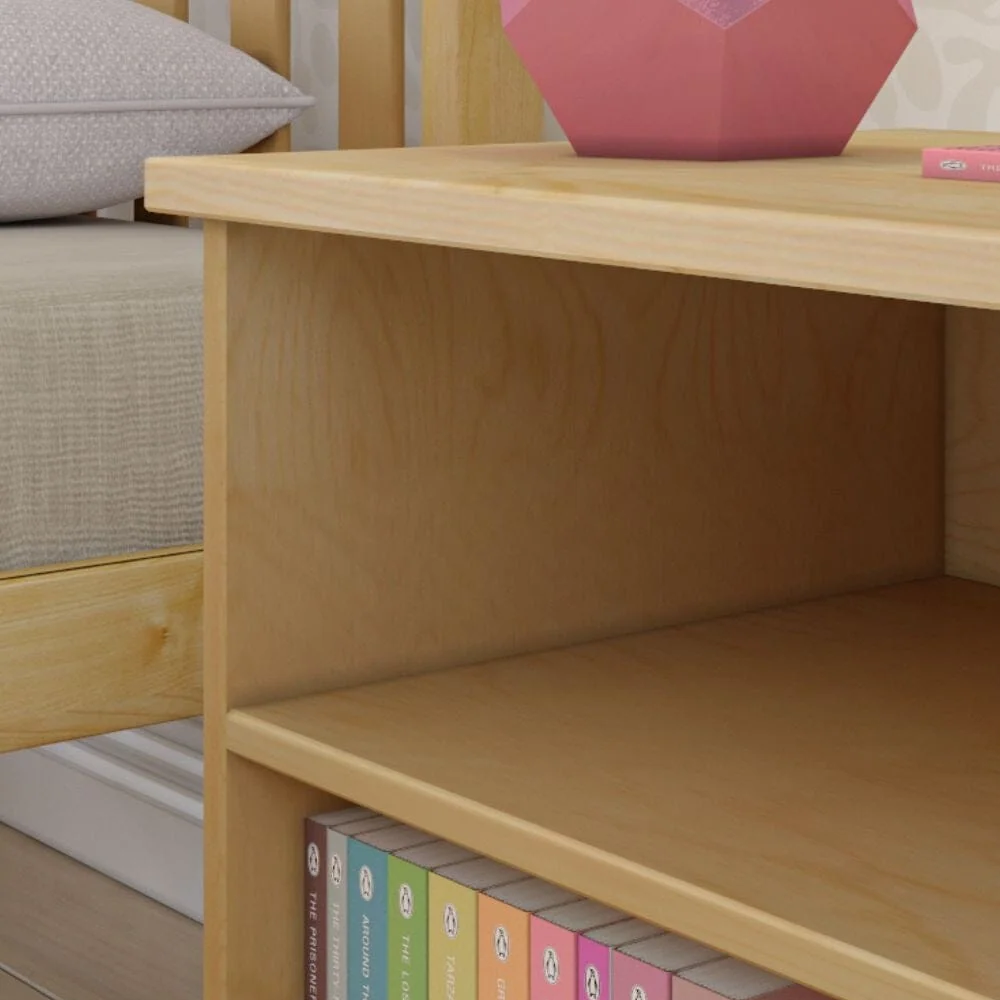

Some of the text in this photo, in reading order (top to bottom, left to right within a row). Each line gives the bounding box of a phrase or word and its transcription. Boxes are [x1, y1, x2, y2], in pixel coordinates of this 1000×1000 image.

[309, 891, 317, 920] THE
[331, 902, 340, 929] THE
[361, 915, 370, 978] AROUND
[401, 934, 410, 964] THE
